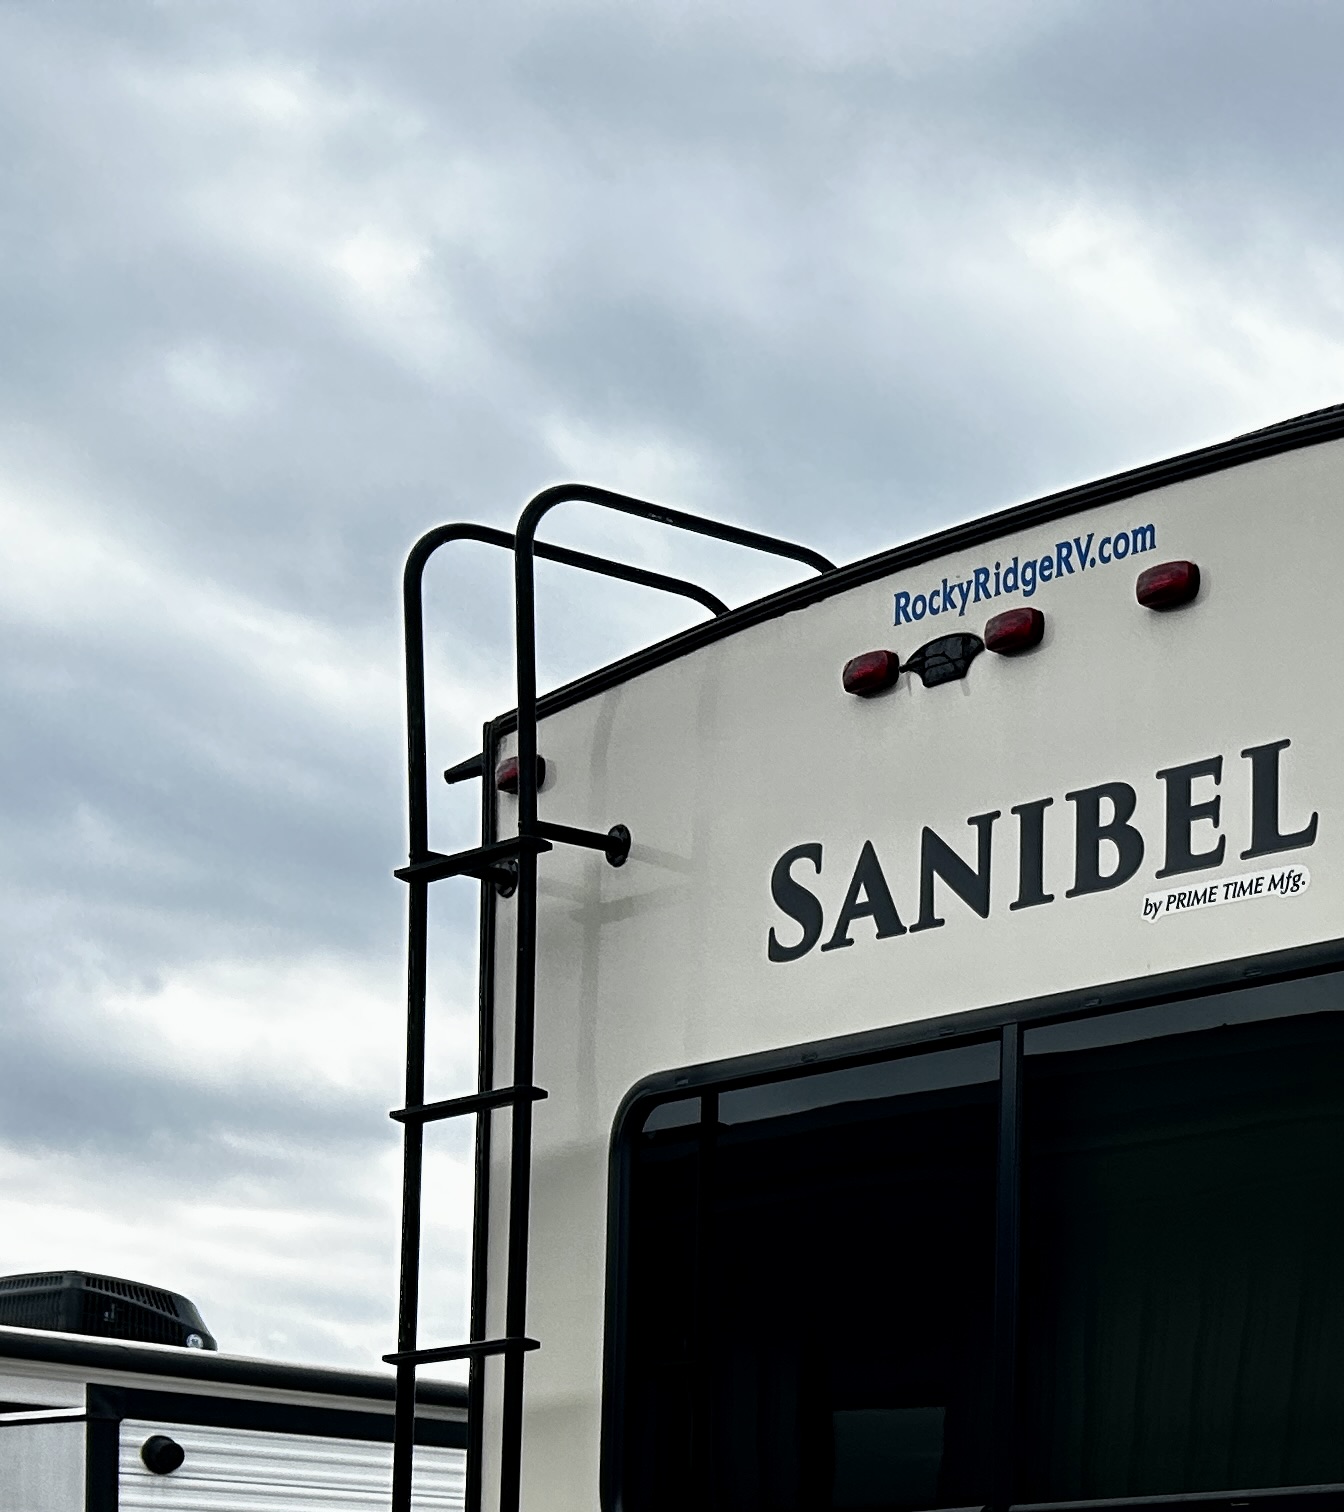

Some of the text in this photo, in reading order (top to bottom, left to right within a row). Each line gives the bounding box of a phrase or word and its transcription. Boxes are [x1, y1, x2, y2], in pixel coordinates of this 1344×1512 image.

[892, 523, 1157, 627] RockyRidgeRV.com
[768, 738, 1319, 964] SANIBEL
[1143, 869, 1306, 920] by PRIME TIME Mfg.
